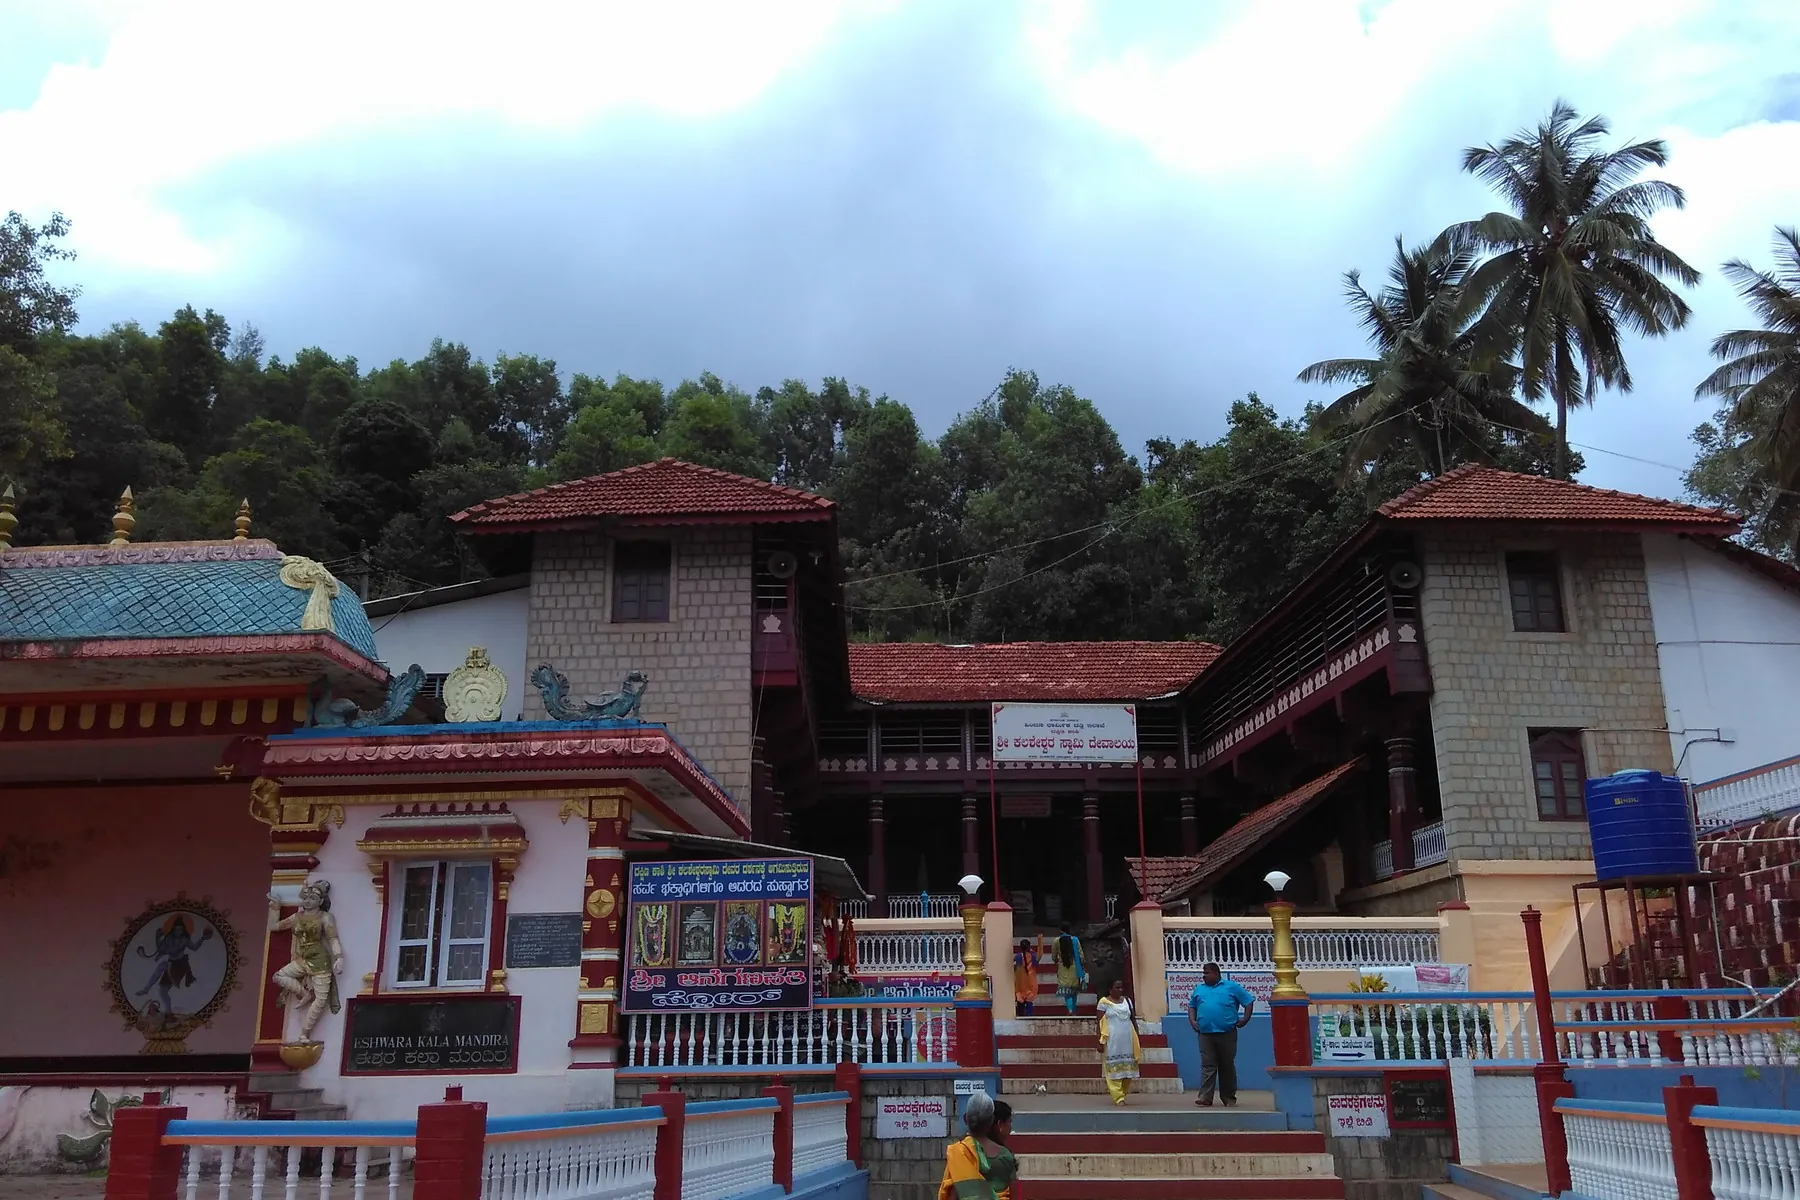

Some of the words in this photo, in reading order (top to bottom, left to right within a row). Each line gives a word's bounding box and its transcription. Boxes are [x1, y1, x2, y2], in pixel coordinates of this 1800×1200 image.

[996, 736, 1009, 752] ಶ್ರೀ
[1013, 736, 1055, 754] ಕಲಶೇಶ್ವರ
[1060, 737, 1084, 754] ಸ್ವಾಮಿ
[1088, 736, 1135, 750] ದೇವಾಲಯ
[633, 882, 657, 895] ಸರ್ವ
[728, 880, 763, 893] ಆದರದ
[766, 878, 809, 897] ಸುಸ್ವಾಗತ
[630, 969, 666, 992] ಶ್ರೀ
[677, 967, 807, 987] ಆನೆಗಣಪತಿ
[353, 1036, 412, 1049] ESHWARA
[417, 1035, 450, 1048] KALA
[455, 1034, 510, 1047] MANDIRA
[404, 1050, 440, 1064] ಕಲಾ
[448, 1048, 508, 1063] ಮಂದಿರ
